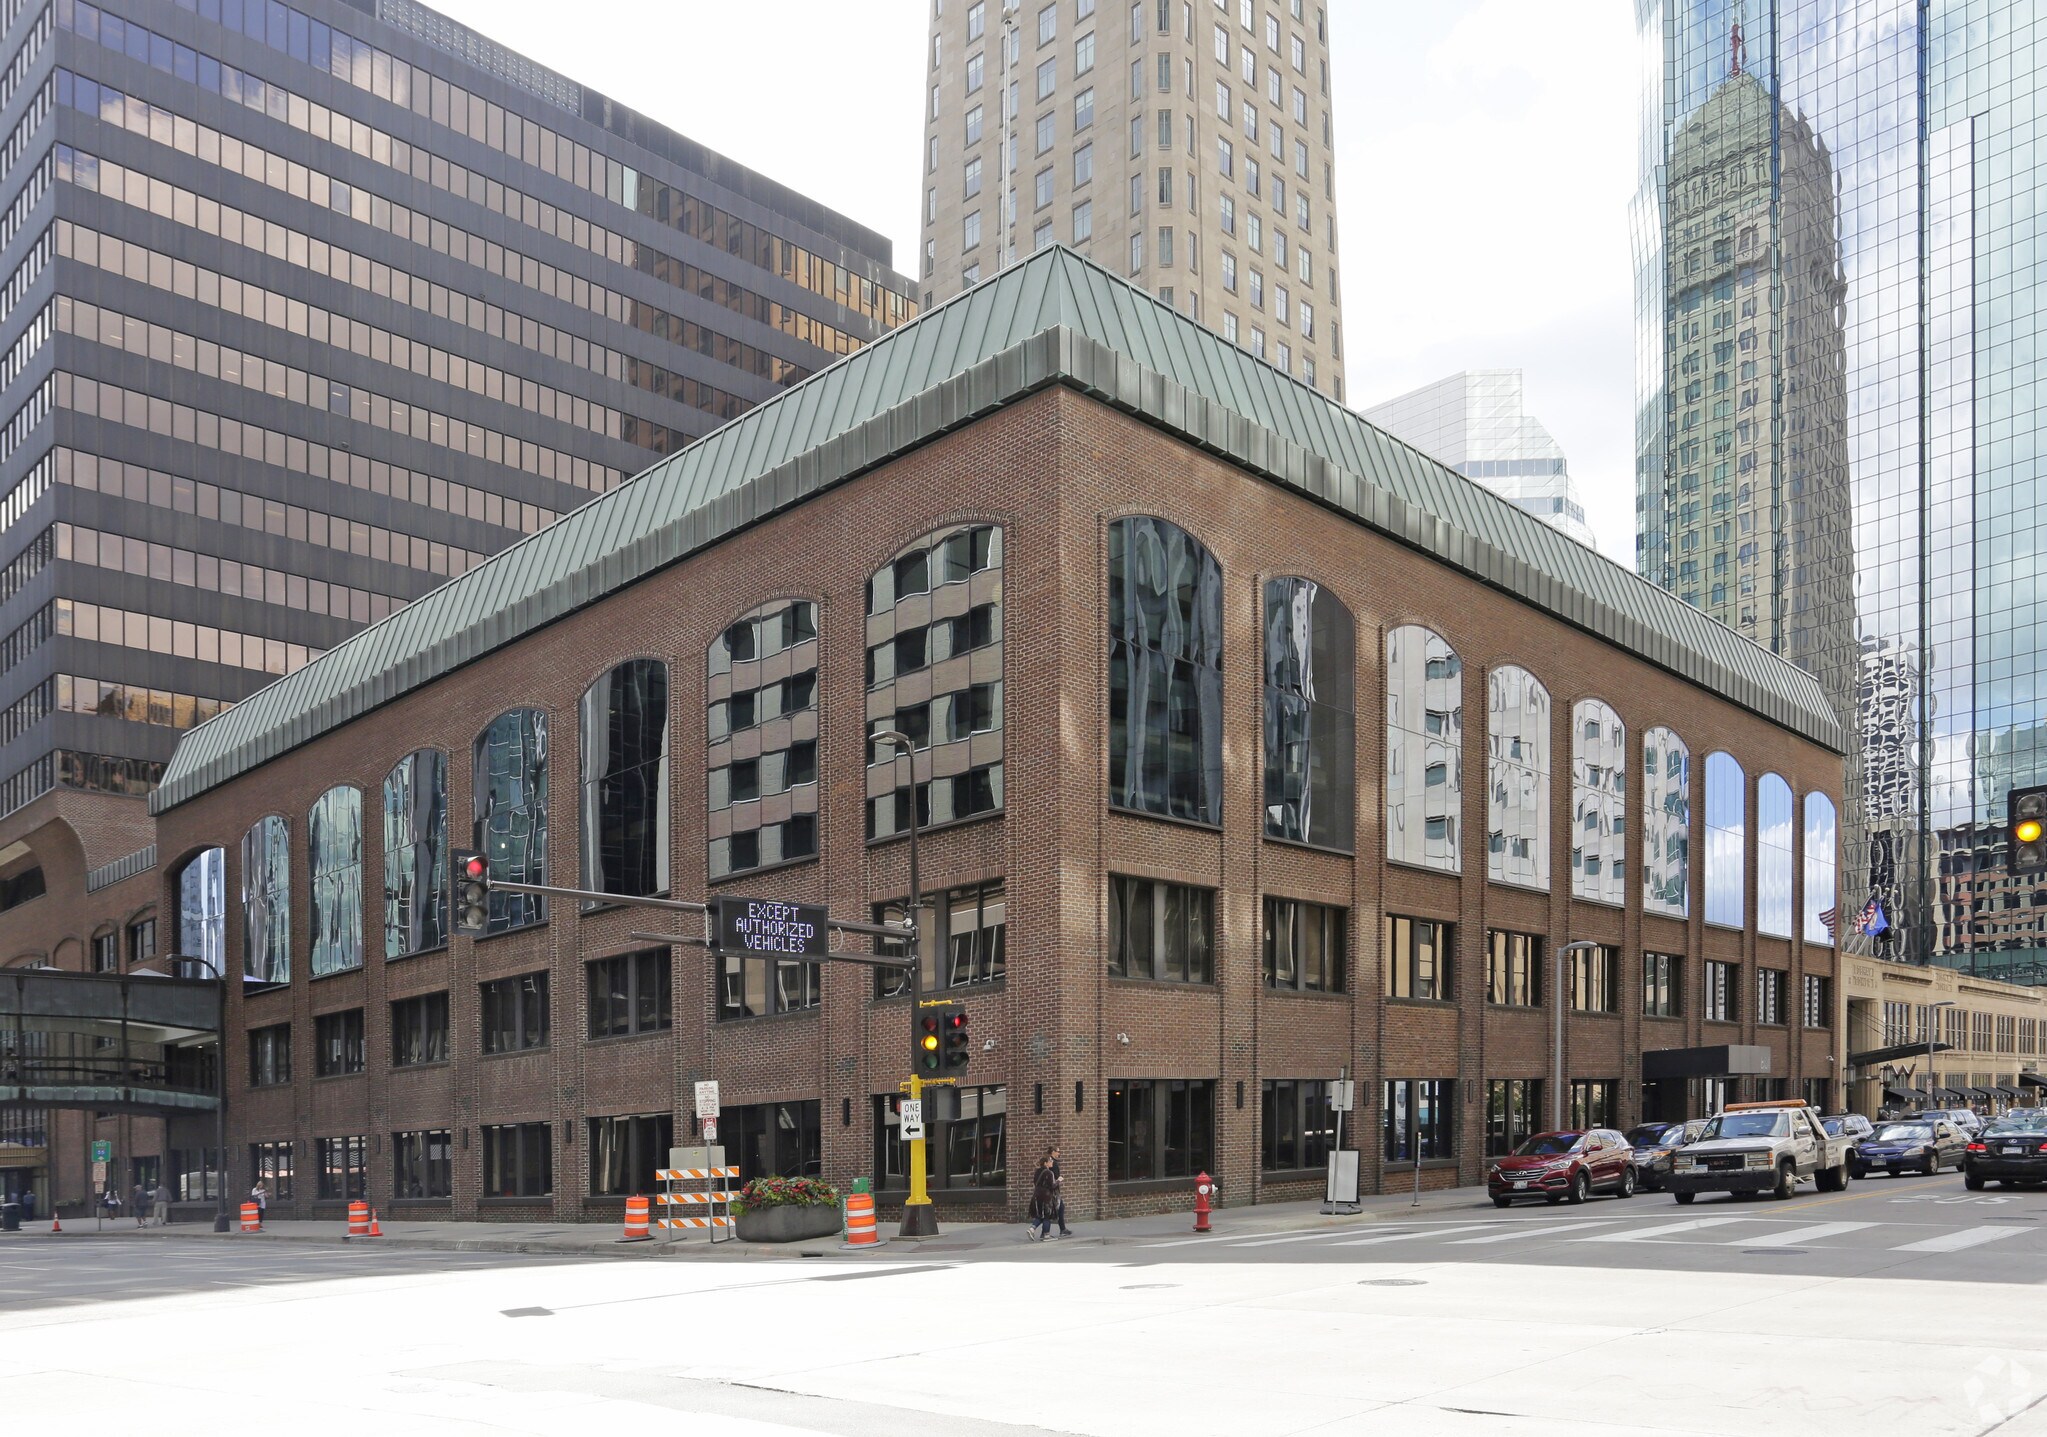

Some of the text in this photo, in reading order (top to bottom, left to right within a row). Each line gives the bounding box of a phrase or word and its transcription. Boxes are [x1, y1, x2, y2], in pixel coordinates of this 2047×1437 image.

[749, 903, 799, 921] EXCEPT
[736, 918, 814, 938] AUTHORIZED
[745, 934, 805, 953] VEHICLES
[904, 1103, 919, 1112] ONE
[904, 1113, 920, 1123] WAY
